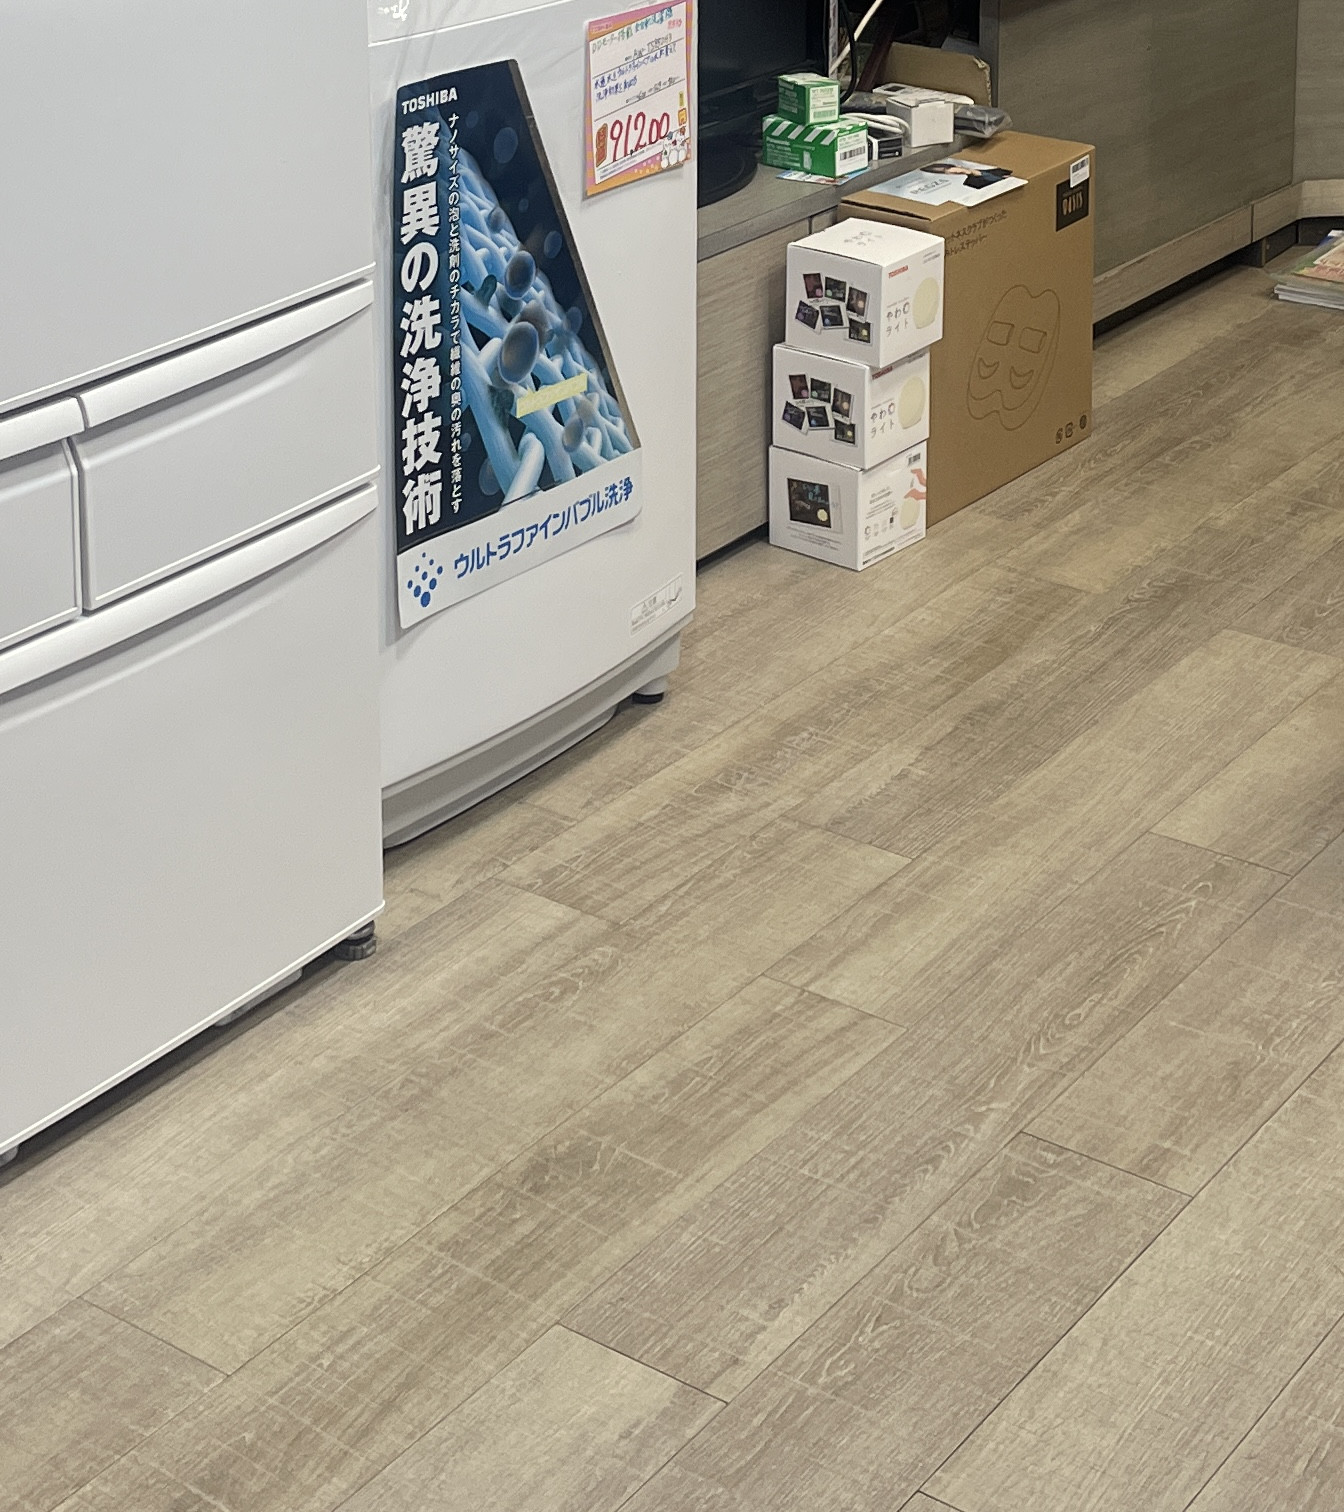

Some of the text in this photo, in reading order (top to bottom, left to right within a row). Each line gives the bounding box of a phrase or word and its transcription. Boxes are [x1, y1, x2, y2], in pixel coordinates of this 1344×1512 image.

[401, 86, 458, 114] TOSHIBA
[610, 111, 670, 163] 91,200
[888, 266, 908, 279] TOSHIBA
[399, 120, 443, 536] 驚異の洗浄技術
[447, 112, 462, 516] ナノサイズの泡と洗剤のチカラで繊維の奥の汚れを落とす
[872, 366, 893, 380] TOSHIBA
[451, 474, 634, 584] ウルトラファインバブル洗浄
